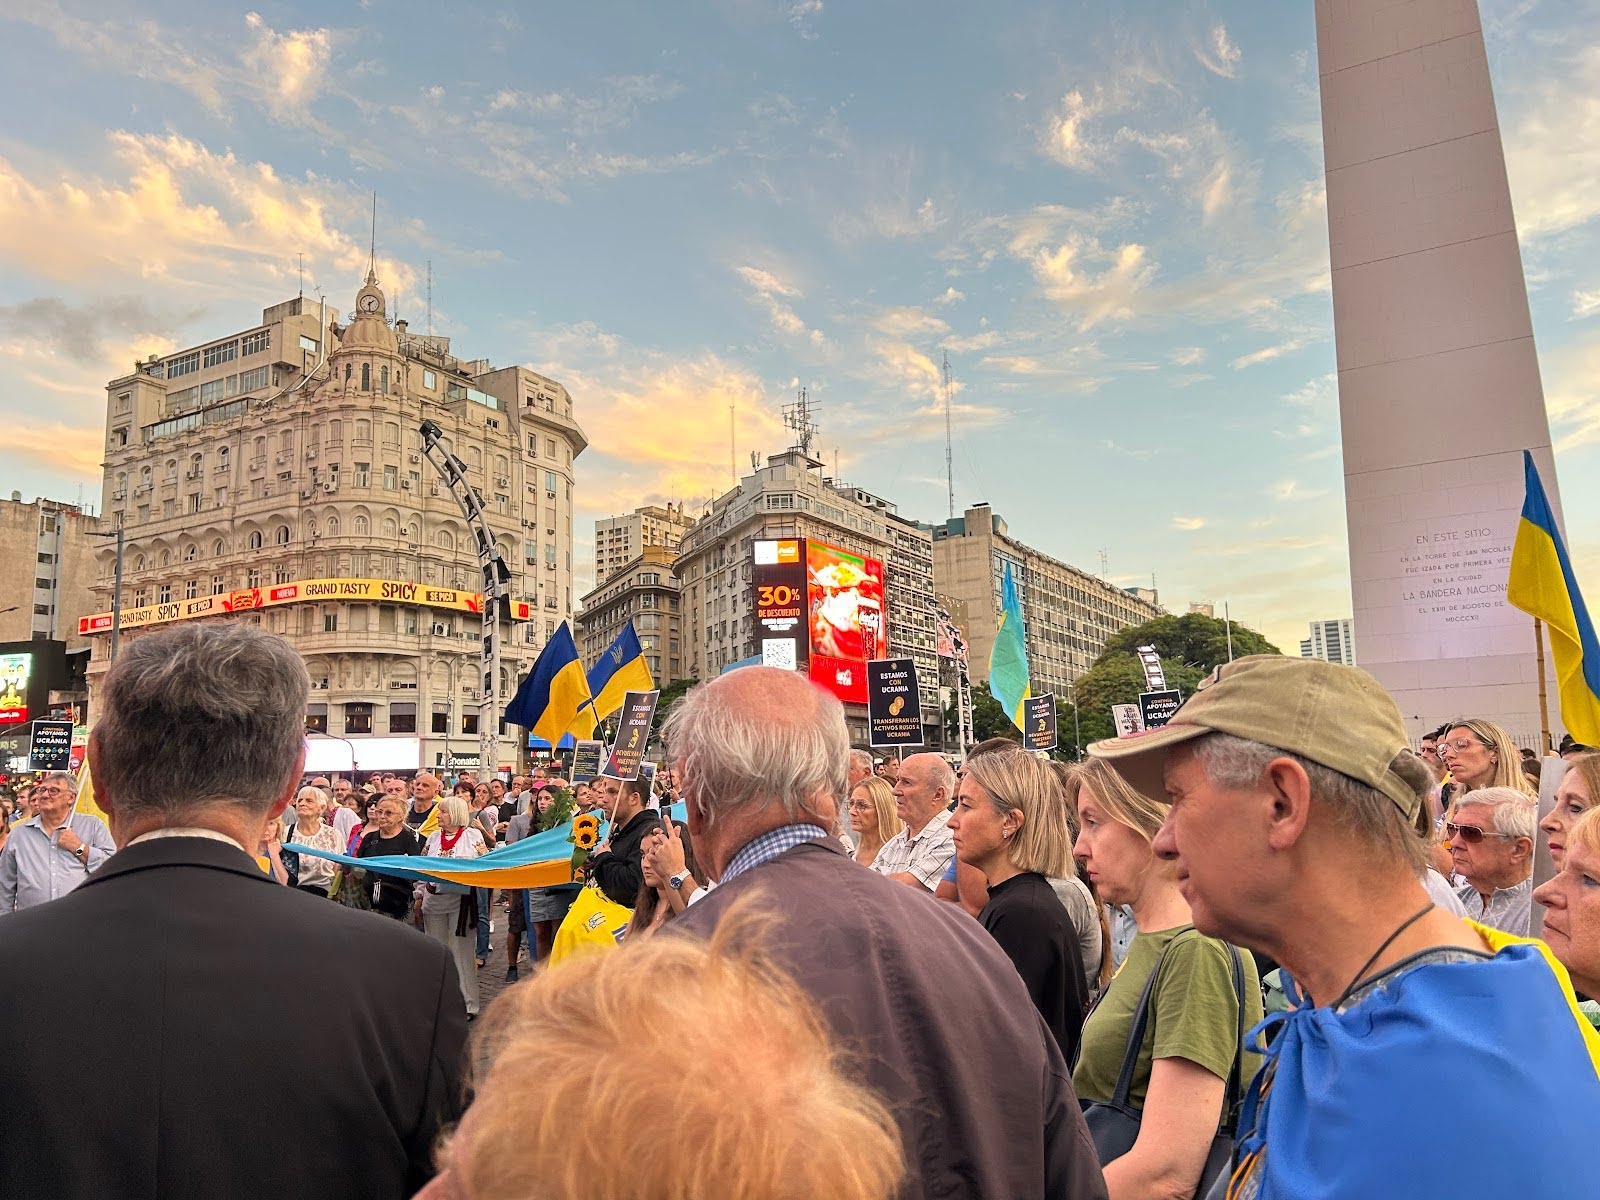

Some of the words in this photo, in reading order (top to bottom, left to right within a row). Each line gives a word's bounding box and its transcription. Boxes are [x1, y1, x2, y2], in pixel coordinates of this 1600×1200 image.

[1416, 536, 1428, 544] EN
[1434, 532, 1458, 542] ESTE
[1464, 528, 1491, 538] SITIO
[276, 587, 296, 599] NUEVA
[306, 584, 337, 596] GRAND
[340, 583, 370, 595] TASTY
[381, 582, 417, 600] SPICY
[429, 591, 438, 601] SE
[758, 585, 800, 606] 30%
[1403, 592, 1415, 600] LA
[1420, 587, 1462, 599] BANDERA
[1467, 583, 1509, 595] NACIONA
[95, 616, 111, 627] NUEVA
[119, 612, 135, 624] RAND
[136, 610, 152, 622] TASTY
[158, 603, 181, 620] SPICY
[190, 604, 197, 614] SE
[758, 609, 767, 617] DE
[767, 608, 800, 617] DESCUENTO
[880, 672, 908, 680] ESTAMOS
